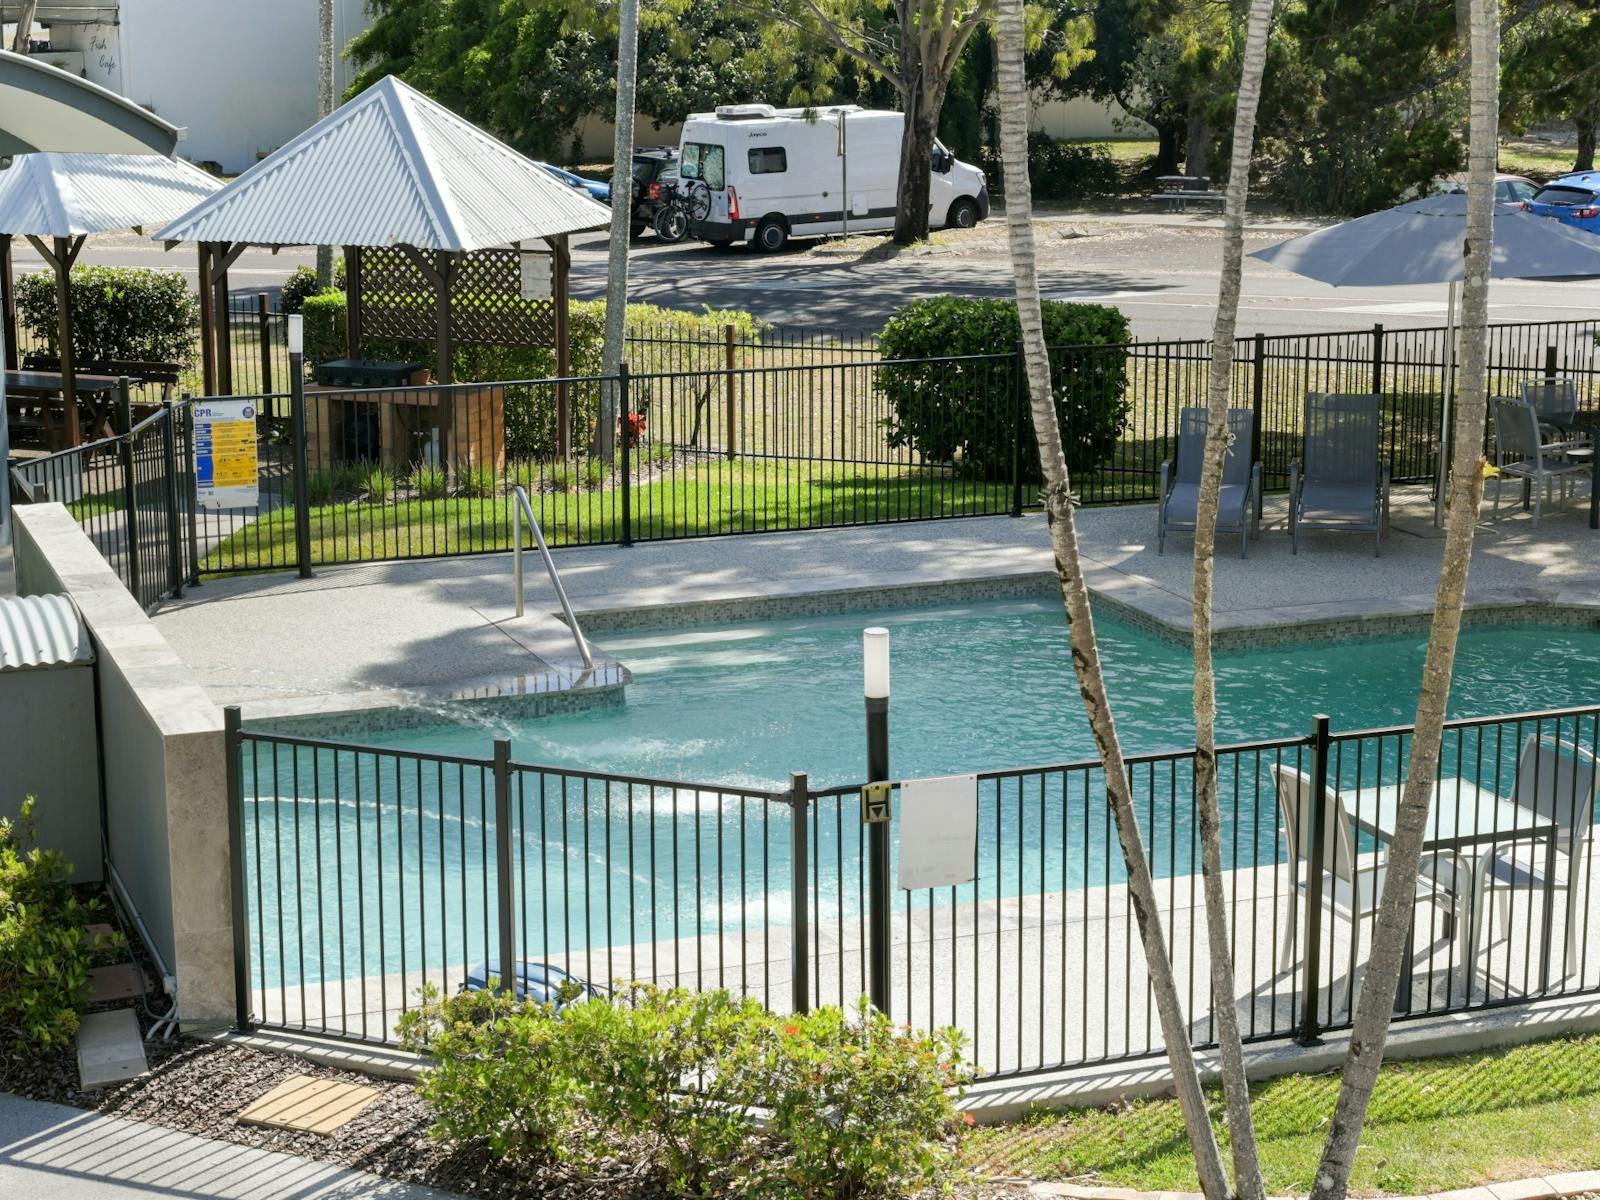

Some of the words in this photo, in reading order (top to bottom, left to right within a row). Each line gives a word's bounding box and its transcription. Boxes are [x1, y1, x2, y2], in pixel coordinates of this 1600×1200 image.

[89, 35, 107, 51] Fish
[98, 54, 117, 75] Cafe
[748, 131, 768, 139] Jayco
[194, 408, 212, 418] CPR
